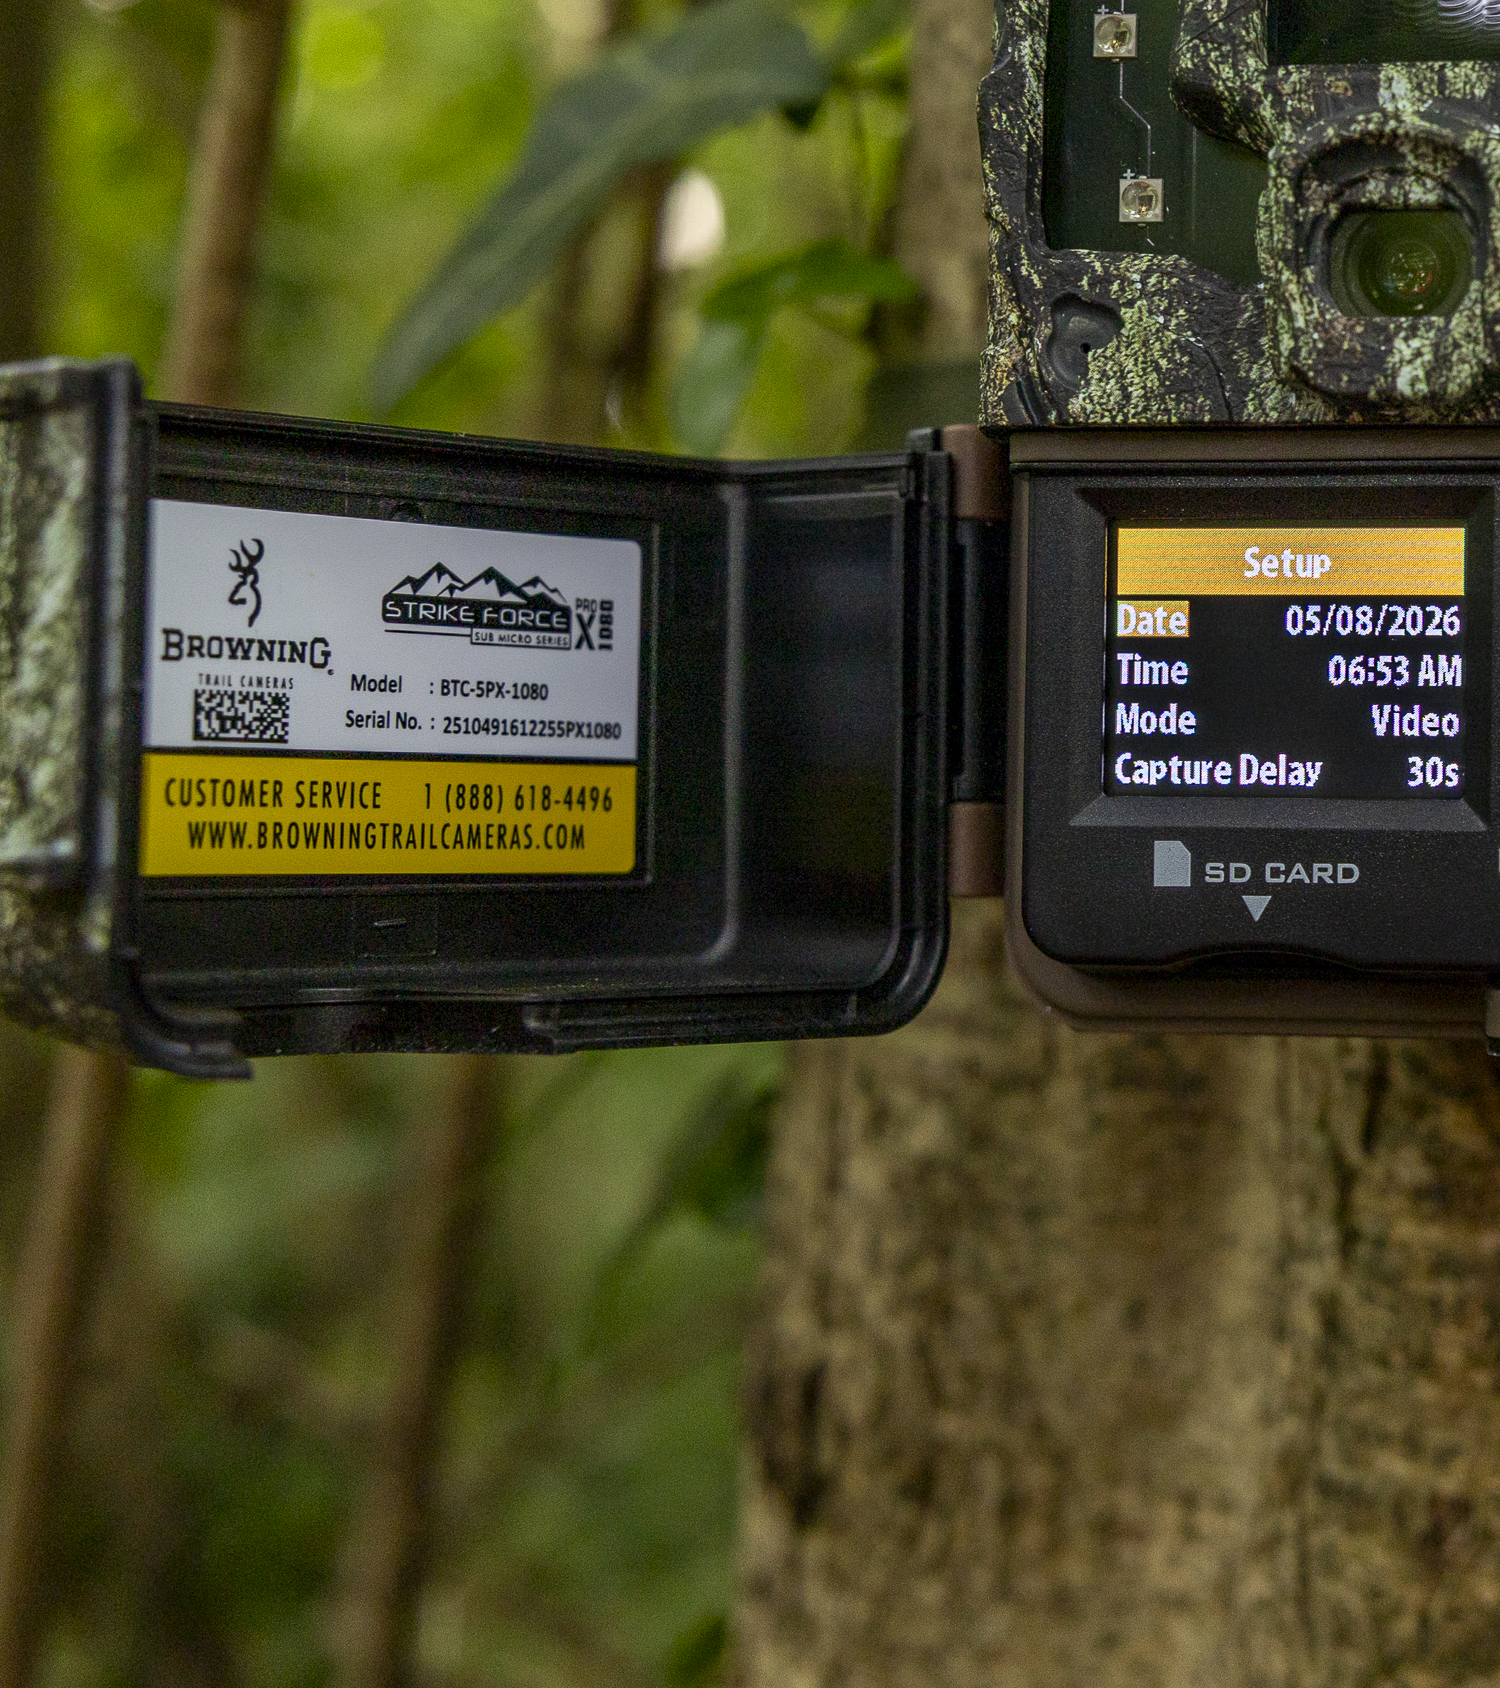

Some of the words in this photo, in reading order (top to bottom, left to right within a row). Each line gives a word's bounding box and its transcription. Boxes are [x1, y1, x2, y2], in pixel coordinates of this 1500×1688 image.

[1243, 546, 1332, 579] Setup
[386, 601, 475, 622] STRIKE
[483, 607, 568, 629] FORCE
[575, 598, 598, 612] PRO
[1117, 603, 1188, 635] Date
[1285, 604, 1461, 636] 05/08/2026
[474, 632, 495, 642] SUB
[498, 634, 532, 644] MICRO
[536, 636, 569, 646] SERIES
[575, 613, 597, 650] X
[598, 599, 614, 650] 1080
[161, 628, 332, 669] BROWNING
[199, 673, 233, 687] TRAIL
[240, 675, 294, 689] CAMERAS
[1117, 653, 1189, 685] Time
[1328, 655, 1410, 686] 06:53
[1418, 655, 1462, 687] AM
[350, 674, 403, 694] Model
[440, 679, 549, 700] BTC-5PX-1080
[345, 710, 390, 730] Serial
[395, 712, 422, 730] No.
[443, 716, 622, 740] 2510491612255PX1080
[1115, 703, 1196, 735] Mode
[1371, 704, 1460, 737] Video
[1115, 752, 1232, 786] Capture
[1239, 753, 1323, 787] Delay
[1407, 756, 1460, 787] 30s
[165, 778, 283, 808] CUSTOMER
[295, 780, 382, 809] SERVICE
[424, 783, 431, 809] 1
[445, 783, 503, 813] (888)
[515, 784, 613, 812] 618-4496
[188, 821, 585, 850] WWW.BROWNINGTRAILCAMERAS.COM
[1204, 862, 1251, 883] SD
[1264, 862, 1360, 884] CARD
